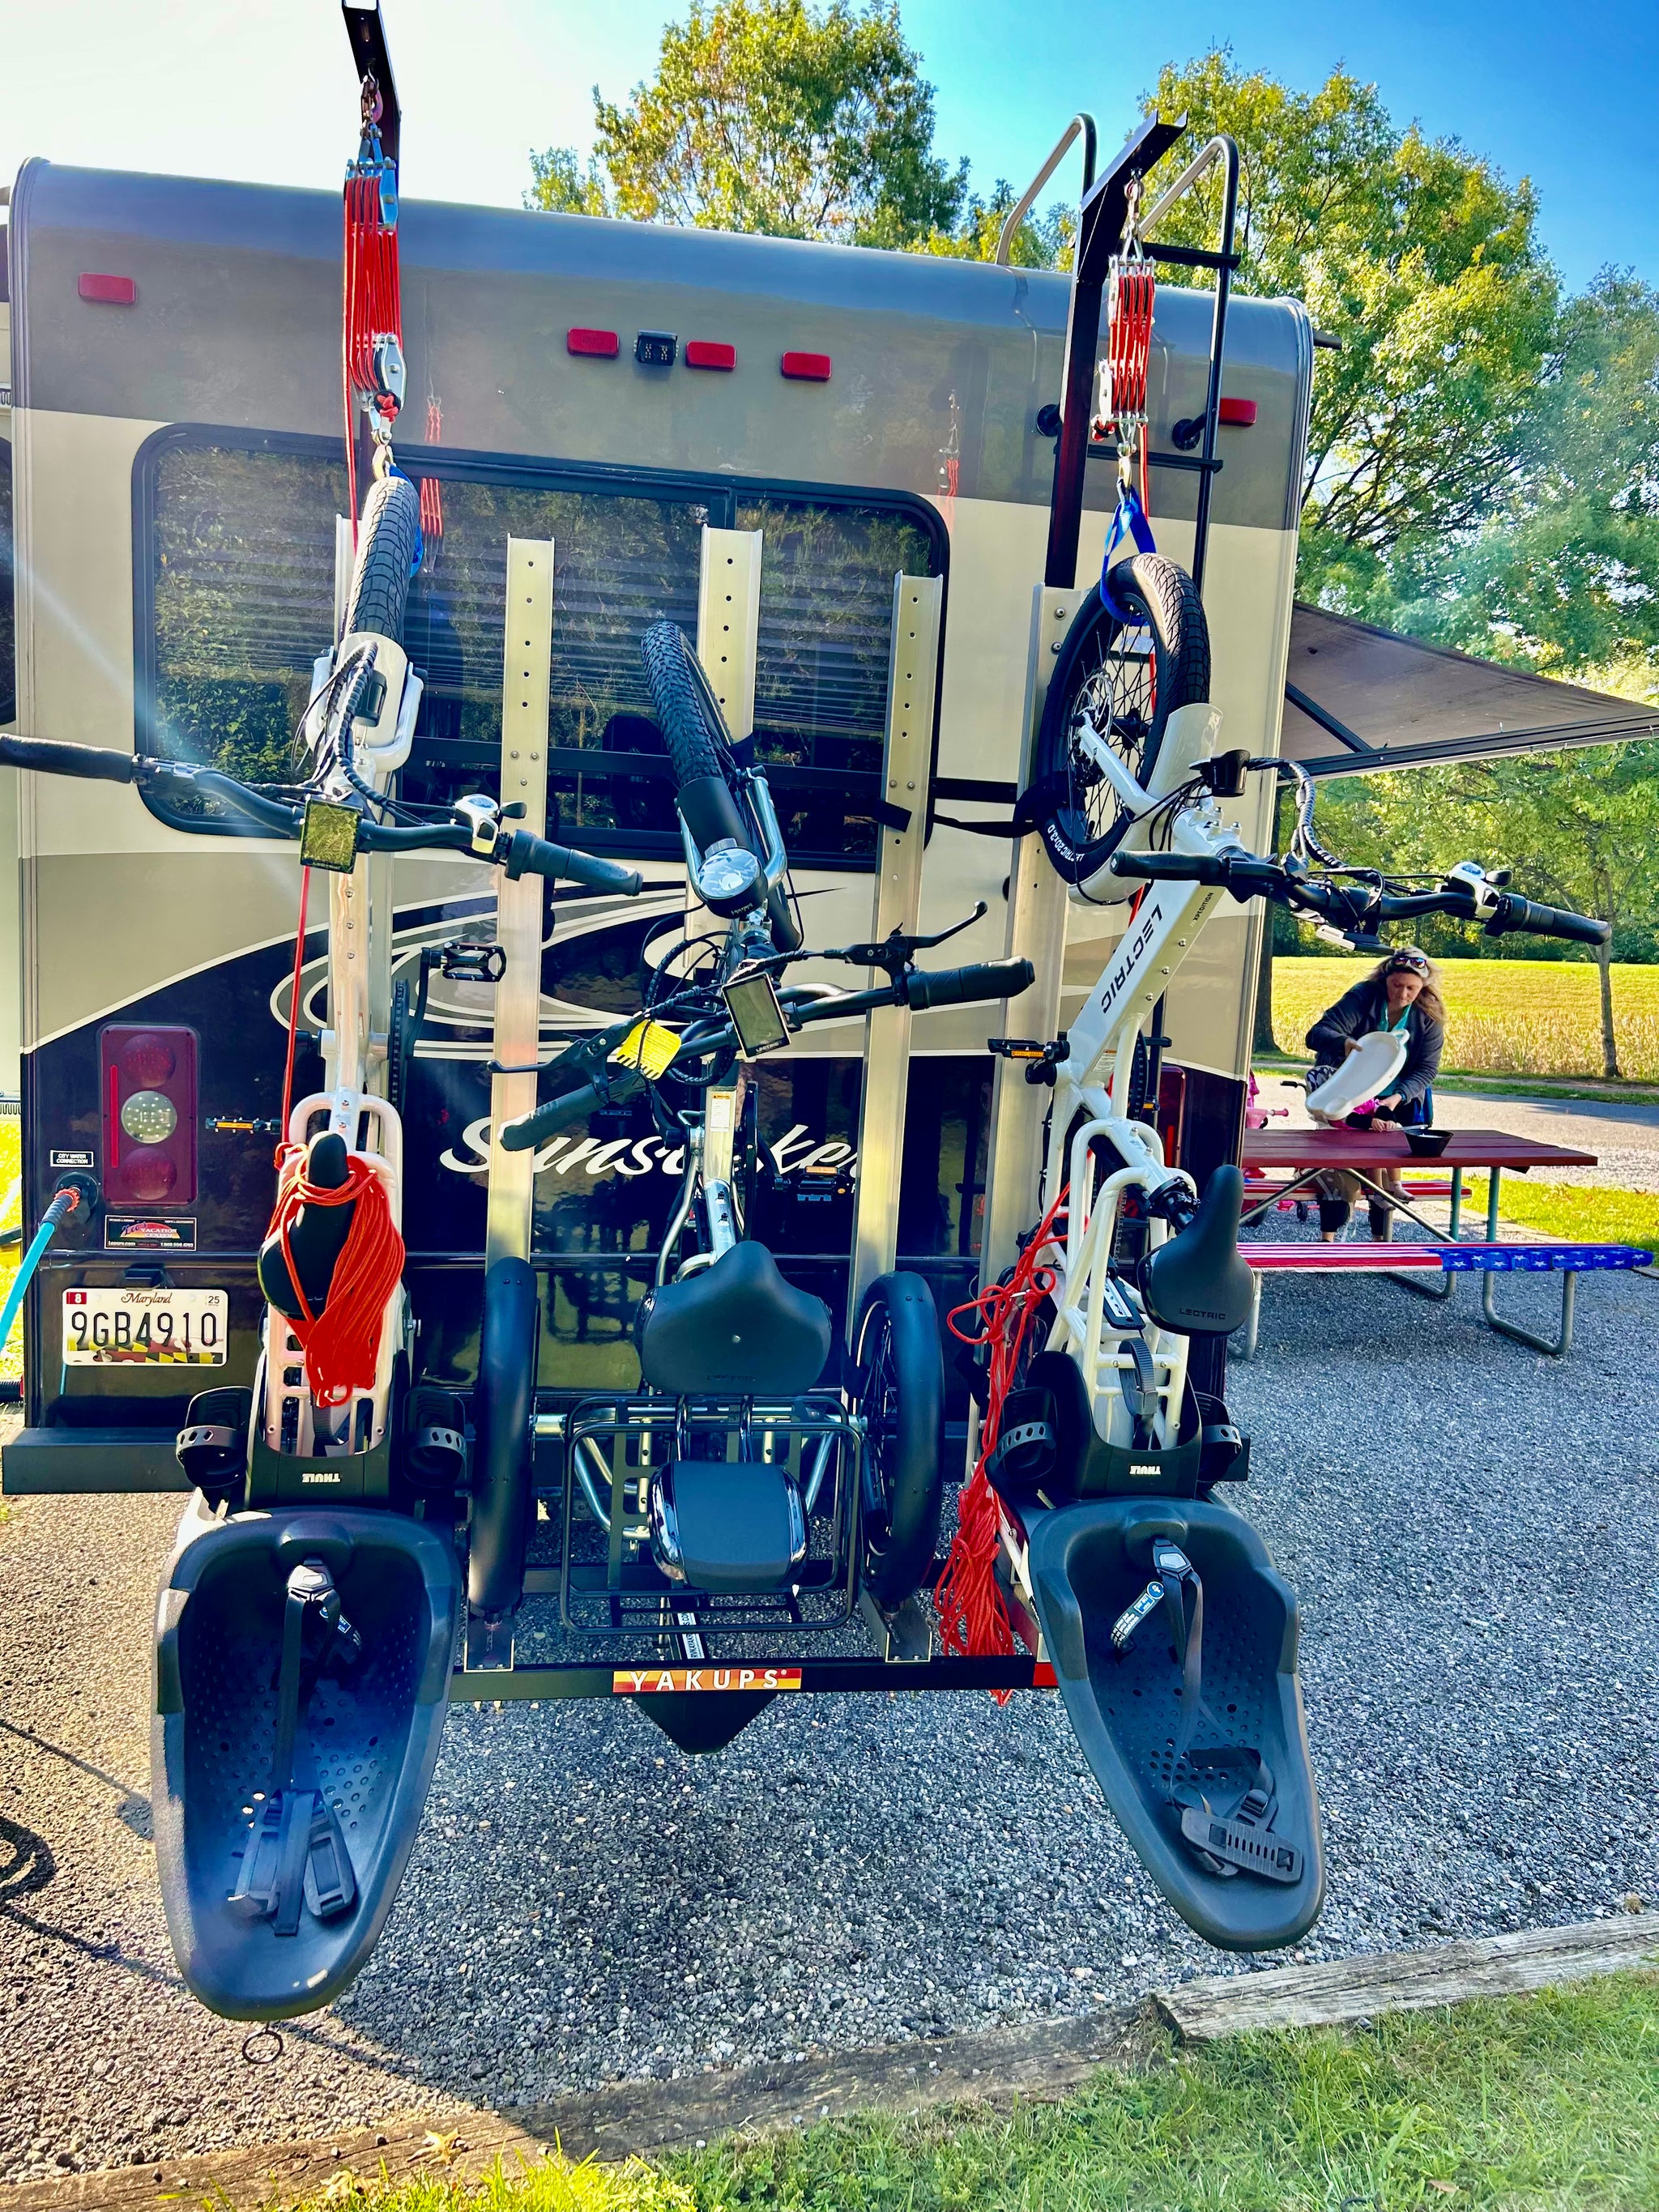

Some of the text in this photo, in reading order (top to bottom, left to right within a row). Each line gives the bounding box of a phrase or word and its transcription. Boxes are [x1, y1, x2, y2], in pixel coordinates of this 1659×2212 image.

[1101, 903, 1162, 1013] LECTRIC
[755, 1041, 779, 1052] LECTRIC
[75, 1293, 220, 1306] 8 Maryland 25
[1179, 1307, 1226, 1320] LECTRIC
[71, 1311, 216, 1348] 9GB4910
[1129, 1465, 1162, 1475] THULE
[302, 1473, 341, 1483] THULE
[630, 1669, 778, 1691] YAKUPS
